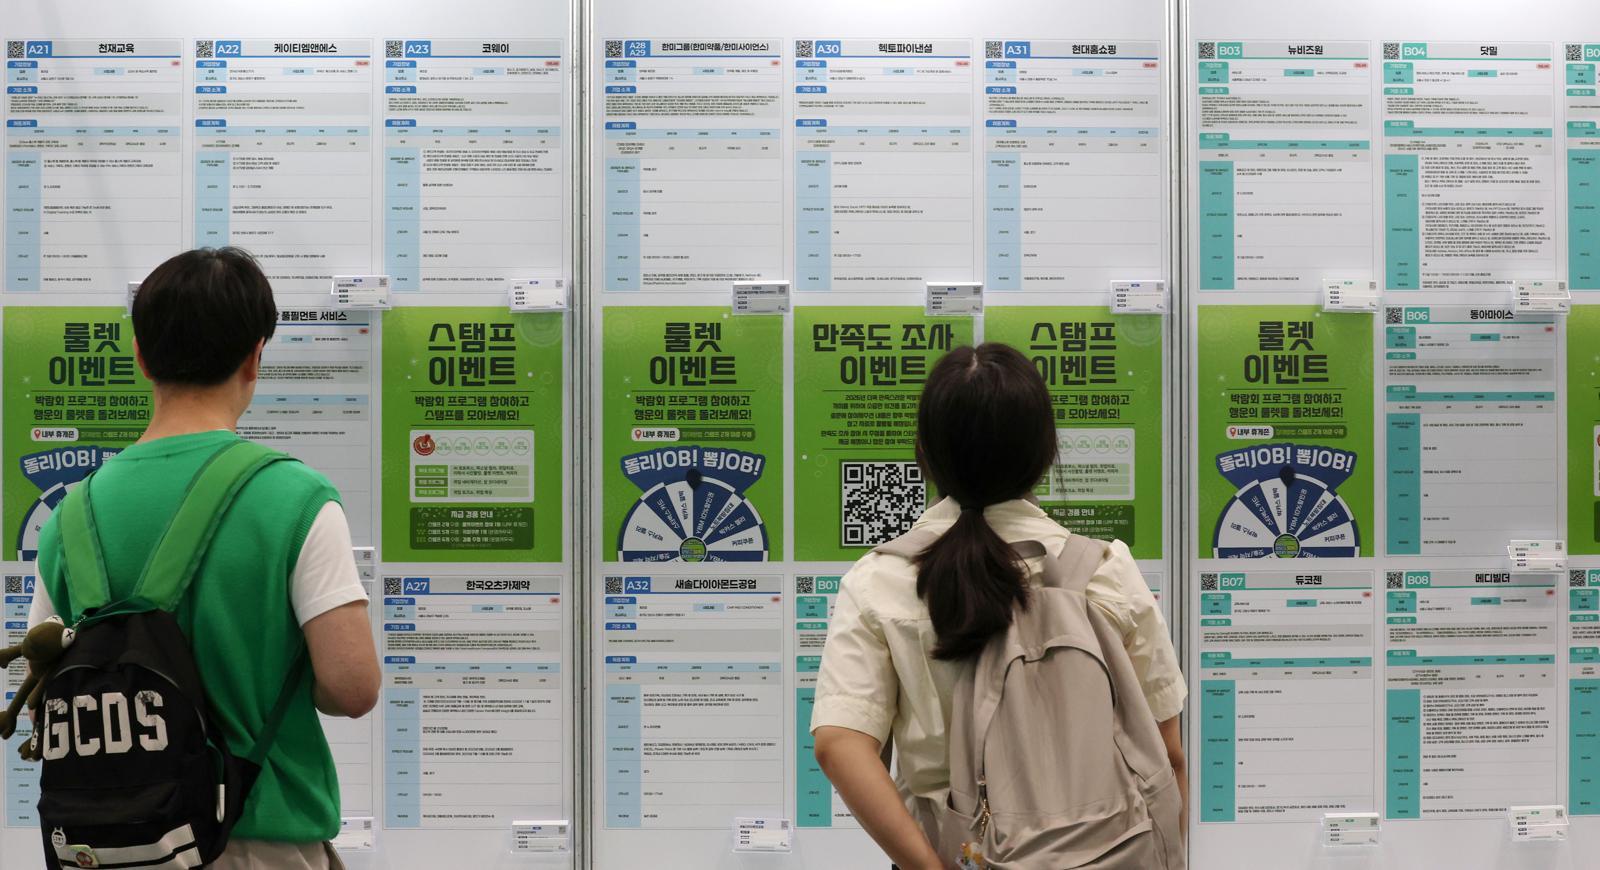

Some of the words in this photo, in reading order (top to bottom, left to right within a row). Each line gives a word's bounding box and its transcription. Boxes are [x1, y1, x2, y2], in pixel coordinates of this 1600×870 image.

[28, 44, 49, 54] A21
[98, 44, 135, 54] 천재교육
[217, 44, 239, 54] A22
[274, 44, 337, 53] 케이티엠앤에스
[407, 44, 429, 54] A23
[482, 44, 509, 54] 코웨이
[817, 44, 839, 54] A30
[878, 44, 933, 54] 헥토파이낸셜
[1007, 45, 1027, 54] A31
[1072, 45, 1117, 54] 현대홈쇼핑
[1220, 47, 1240, 56] B03
[1288, 45, 1324, 55] 뉴비즈원
[1404, 48, 1426, 56] B04
[1587, 49, 1600, 58] B0
[282, 312, 317, 321] 풀필먼트
[320, 312, 347, 321] 서비스
[1407, 312, 1428, 321] B06
[1470, 310, 1514, 320] 동아마이스
[64, 323, 121, 353] 룰렛
[428, 323, 516, 353] 스탬프
[664, 322, 722, 353] 룰렛
[813, 324, 893, 352] 만족도
[901, 324, 954, 352] 조사
[1030, 322, 1117, 352] 스탬프
[1258, 322, 1314, 351] 룰렛
[49, 357, 135, 386] 이벤트
[429, 357, 516, 387] 이벤트
[650, 356, 737, 386] 이벤트
[840, 356, 927, 386] 이벤트
[1032, 356, 1117, 386] 이벤트
[1244, 355, 1329, 385] 이벤트
[35, 396, 64, 407] 박람회
[68, 396, 107, 407] 프로그램
[110, 396, 148, 407] 참여하고
[415, 397, 444, 407] 박람회
[448, 397, 487, 407] 프로그램
[490, 397, 529, 407] 참여하고
[636, 396, 665, 406] 박람회
[668, 396, 708, 406] 프로그램
[711, 396, 751, 406] 참여하고
[1091, 395, 1130, 405] 참여하고
[1231, 394, 1260, 404] 박람회
[1262, 394, 1300, 404] 프로그램
[1304, 394, 1342, 404] 참여하고
[34, 410, 63, 421] 행운의
[66, 410, 95, 421] 룰렛을
[99, 410, 150, 421] 돌려보세요!
[425, 410, 464, 421] 스탬프를
[467, 410, 519, 421] 모아보세요!
[634, 410, 664, 421] 행운의
[667, 410, 696, 421] 룰렛을
[699, 410, 752, 421] 돌려보세요!
[1069, 409, 1120, 419] 모아보세요!
[1229, 408, 1258, 419] 행운의
[1261, 408, 1290, 419] 룰렛을
[1293, 408, 1343, 419] 돌려보세요!
[24, 449, 96, 475] 돌리JOB!
[624, 450, 698, 475] 돌리JOB!
[704, 451, 762, 476] 뽑JOB!
[1220, 447, 1291, 473] 돌리JOB!
[1297, 449, 1354, 472] 뽑JOB!
[480, 511, 494, 519] 안내
[1222, 578, 1244, 587] B07
[1296, 575, 1322, 585] 듀코젠
[1408, 575, 1428, 584] B08
[1476, 573, 1510, 583] 메디빌더
[1591, 573, 1600, 582] B0
[406, 582, 428, 592] A27
[466, 580, 530, 591] 한국오츠카제약
[627, 580, 649, 590] A32
[675, 579, 757, 590] 새솔다이아몬드공업
[819, 580, 838, 590] B01
[43, 690, 168, 761] GCDS
